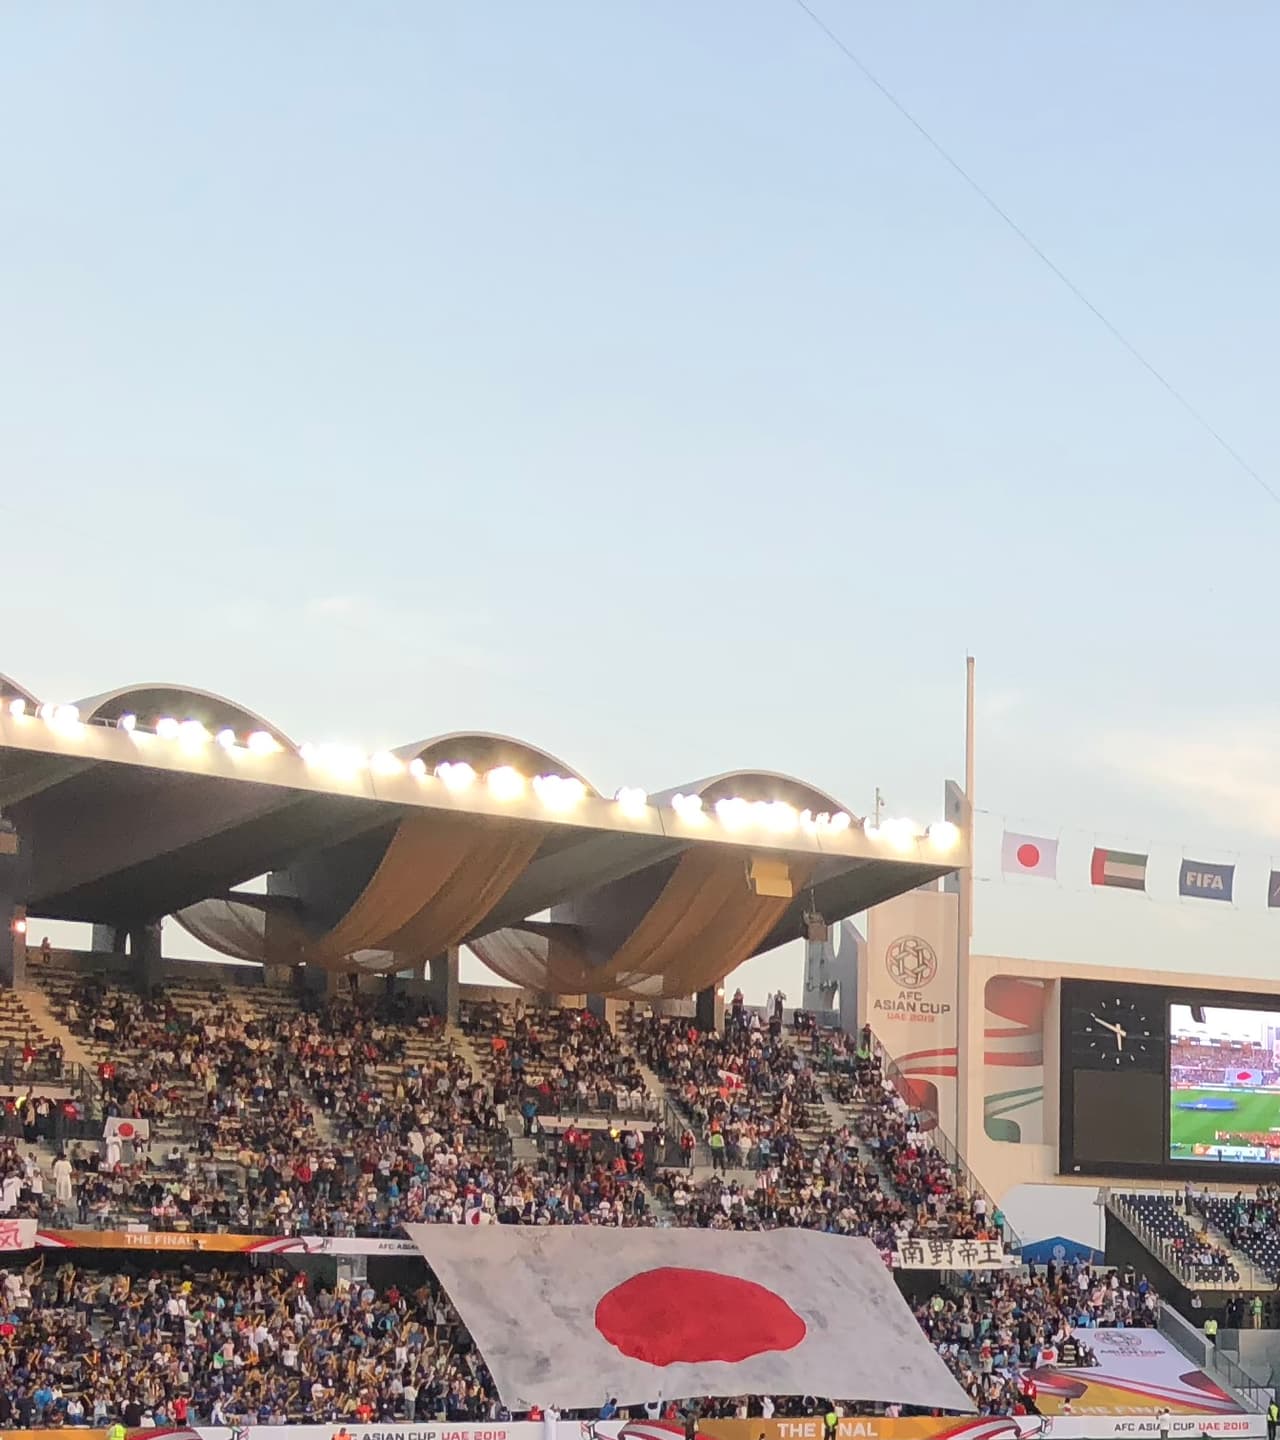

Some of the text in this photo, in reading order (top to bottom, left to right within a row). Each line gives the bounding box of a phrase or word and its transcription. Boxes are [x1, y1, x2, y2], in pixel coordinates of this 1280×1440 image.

[1186, 872, 1224, 890] FIFA
[898, 991, 922, 1000] AFC
[874, 1000, 951, 1014] ASIAN CUP
[124, 1234, 150, 1245] THE
[777, 1422, 879, 1438] THE NAL
[1114, 1422, 1135, 1432] AFC
[1138, 1422, 1170, 1432] ASIA
[1174, 1422, 1195, 1432] CUP
[1199, 1422, 1221, 1431] UAE
[442, 1431, 469, 1440] UAE
